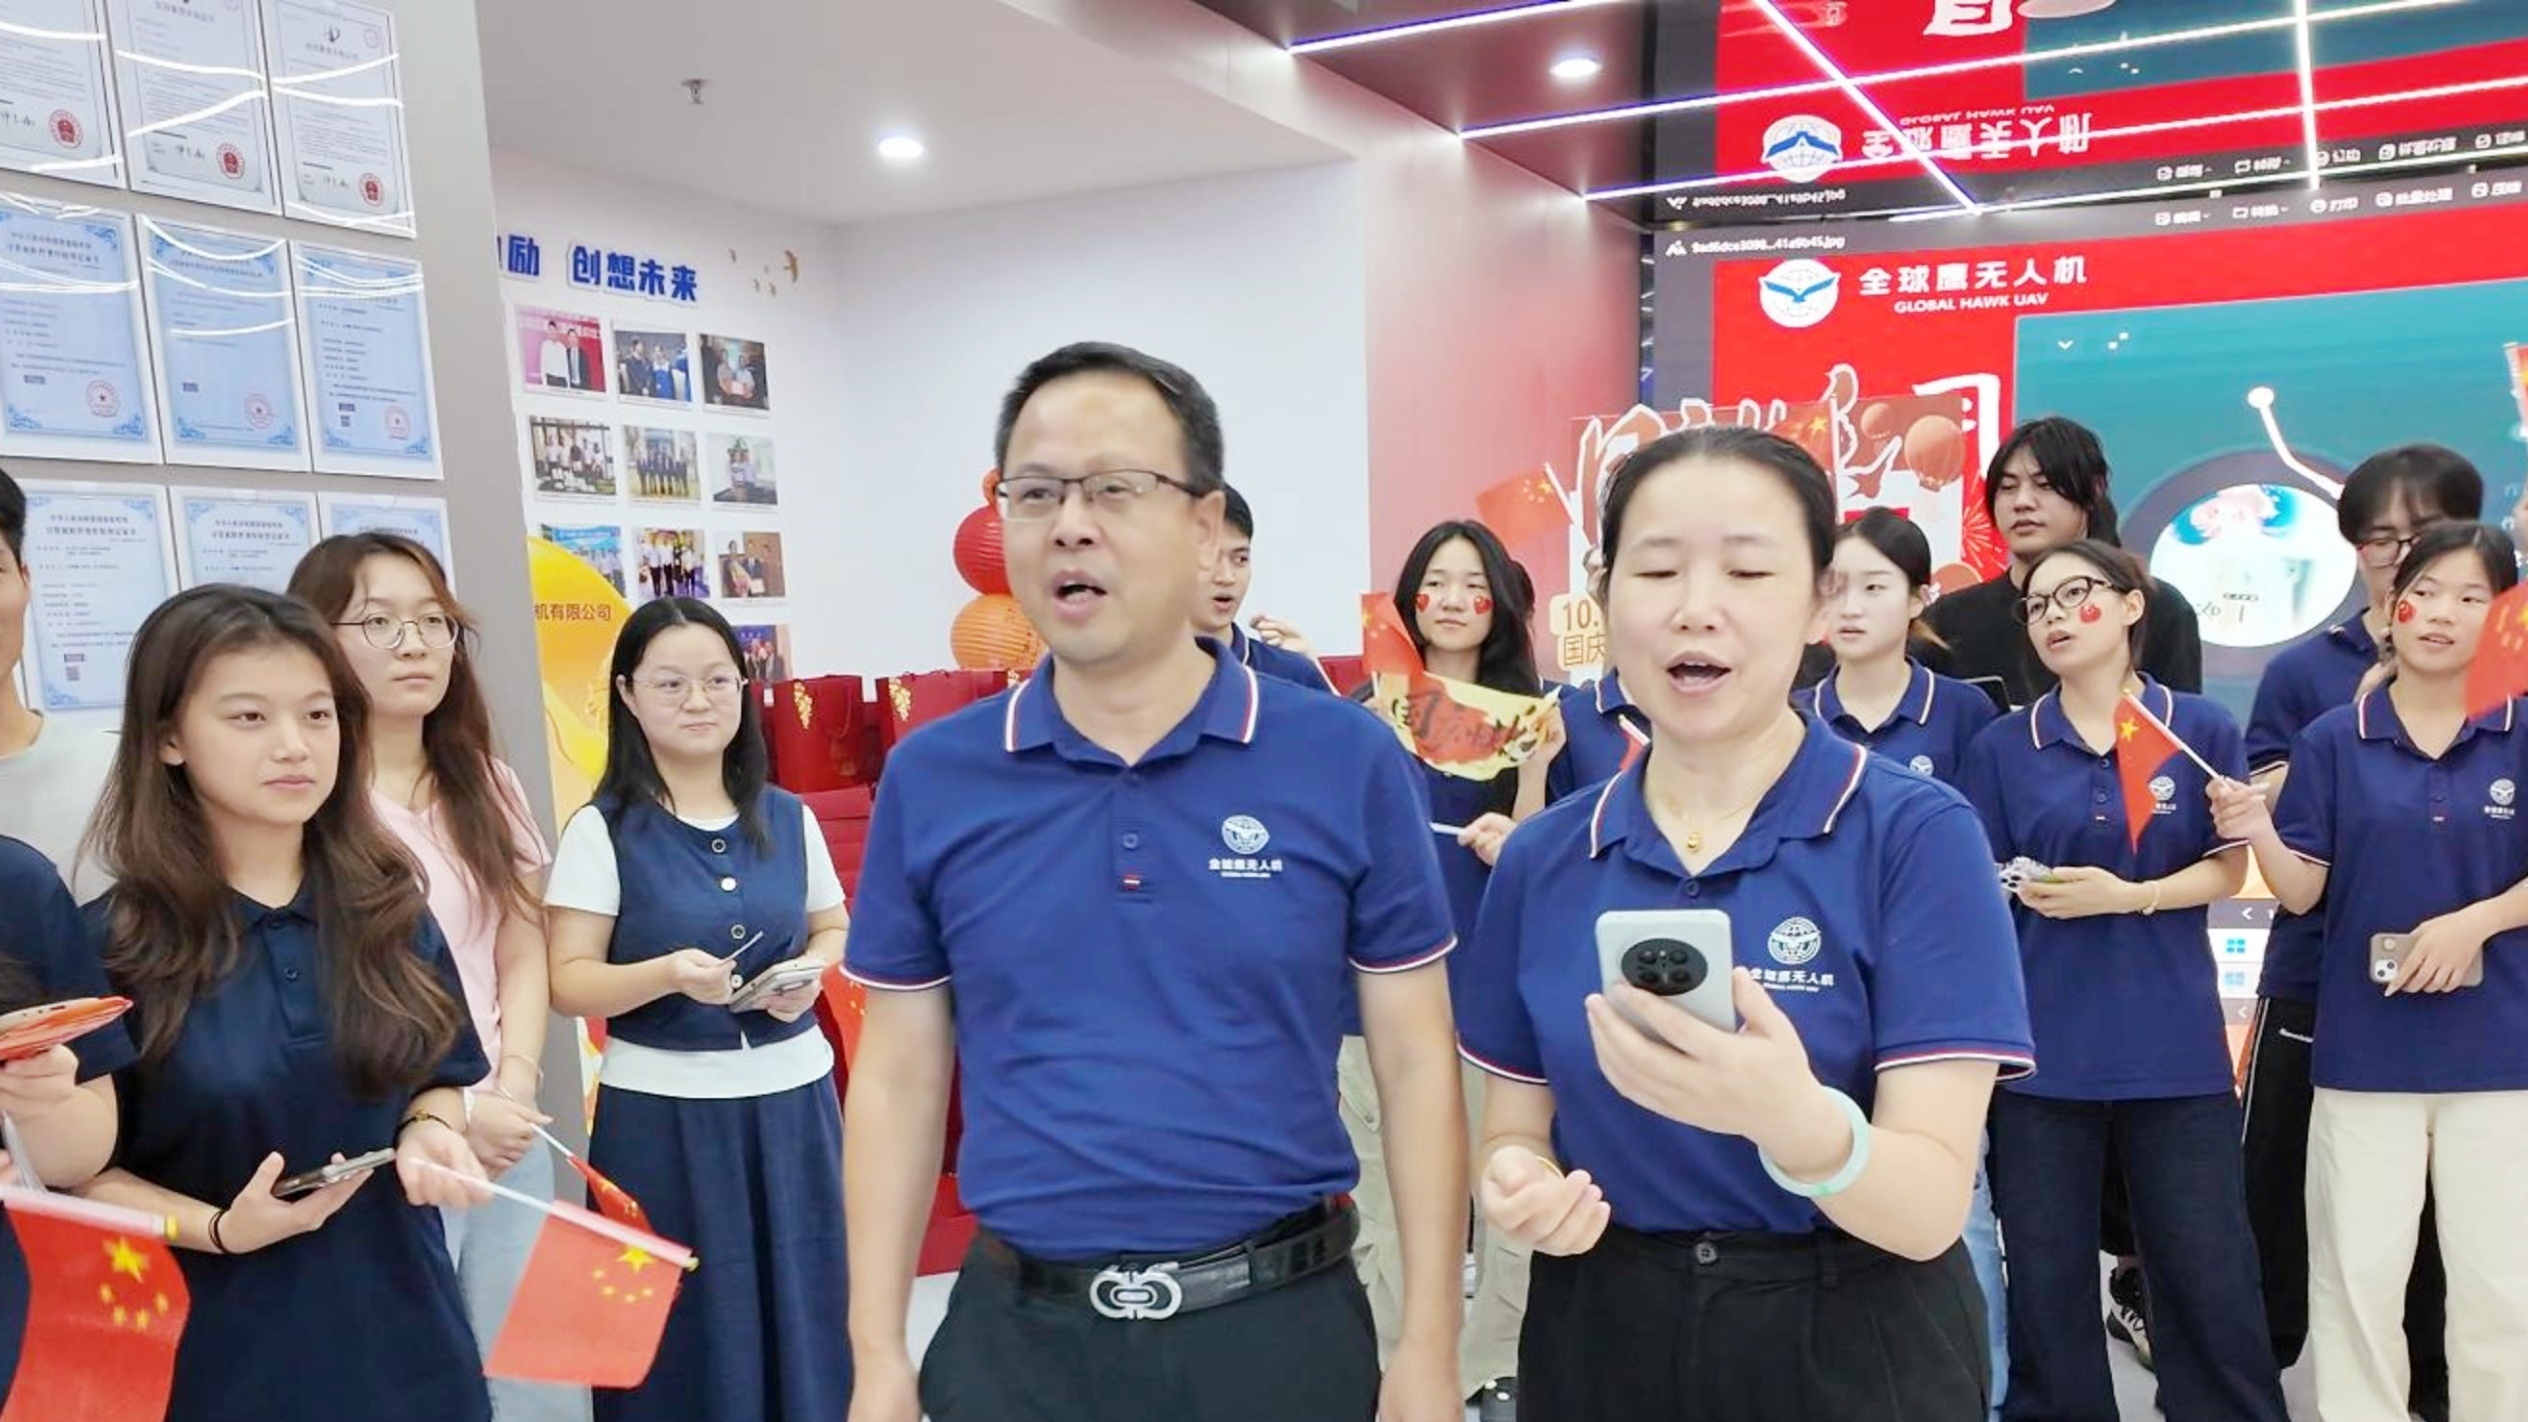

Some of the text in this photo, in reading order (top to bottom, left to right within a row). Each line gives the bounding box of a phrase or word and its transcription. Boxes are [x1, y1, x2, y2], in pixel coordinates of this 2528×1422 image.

[498, 234, 698, 302] 励 创想未来
[1859, 255, 2088, 296] 全球鹰无人机
[1894, 292, 2049, 314] GLOBAL HAWK UAV
[534, 603, 612, 621] 机有限公司
[1563, 631, 1606, 667] 国庆
